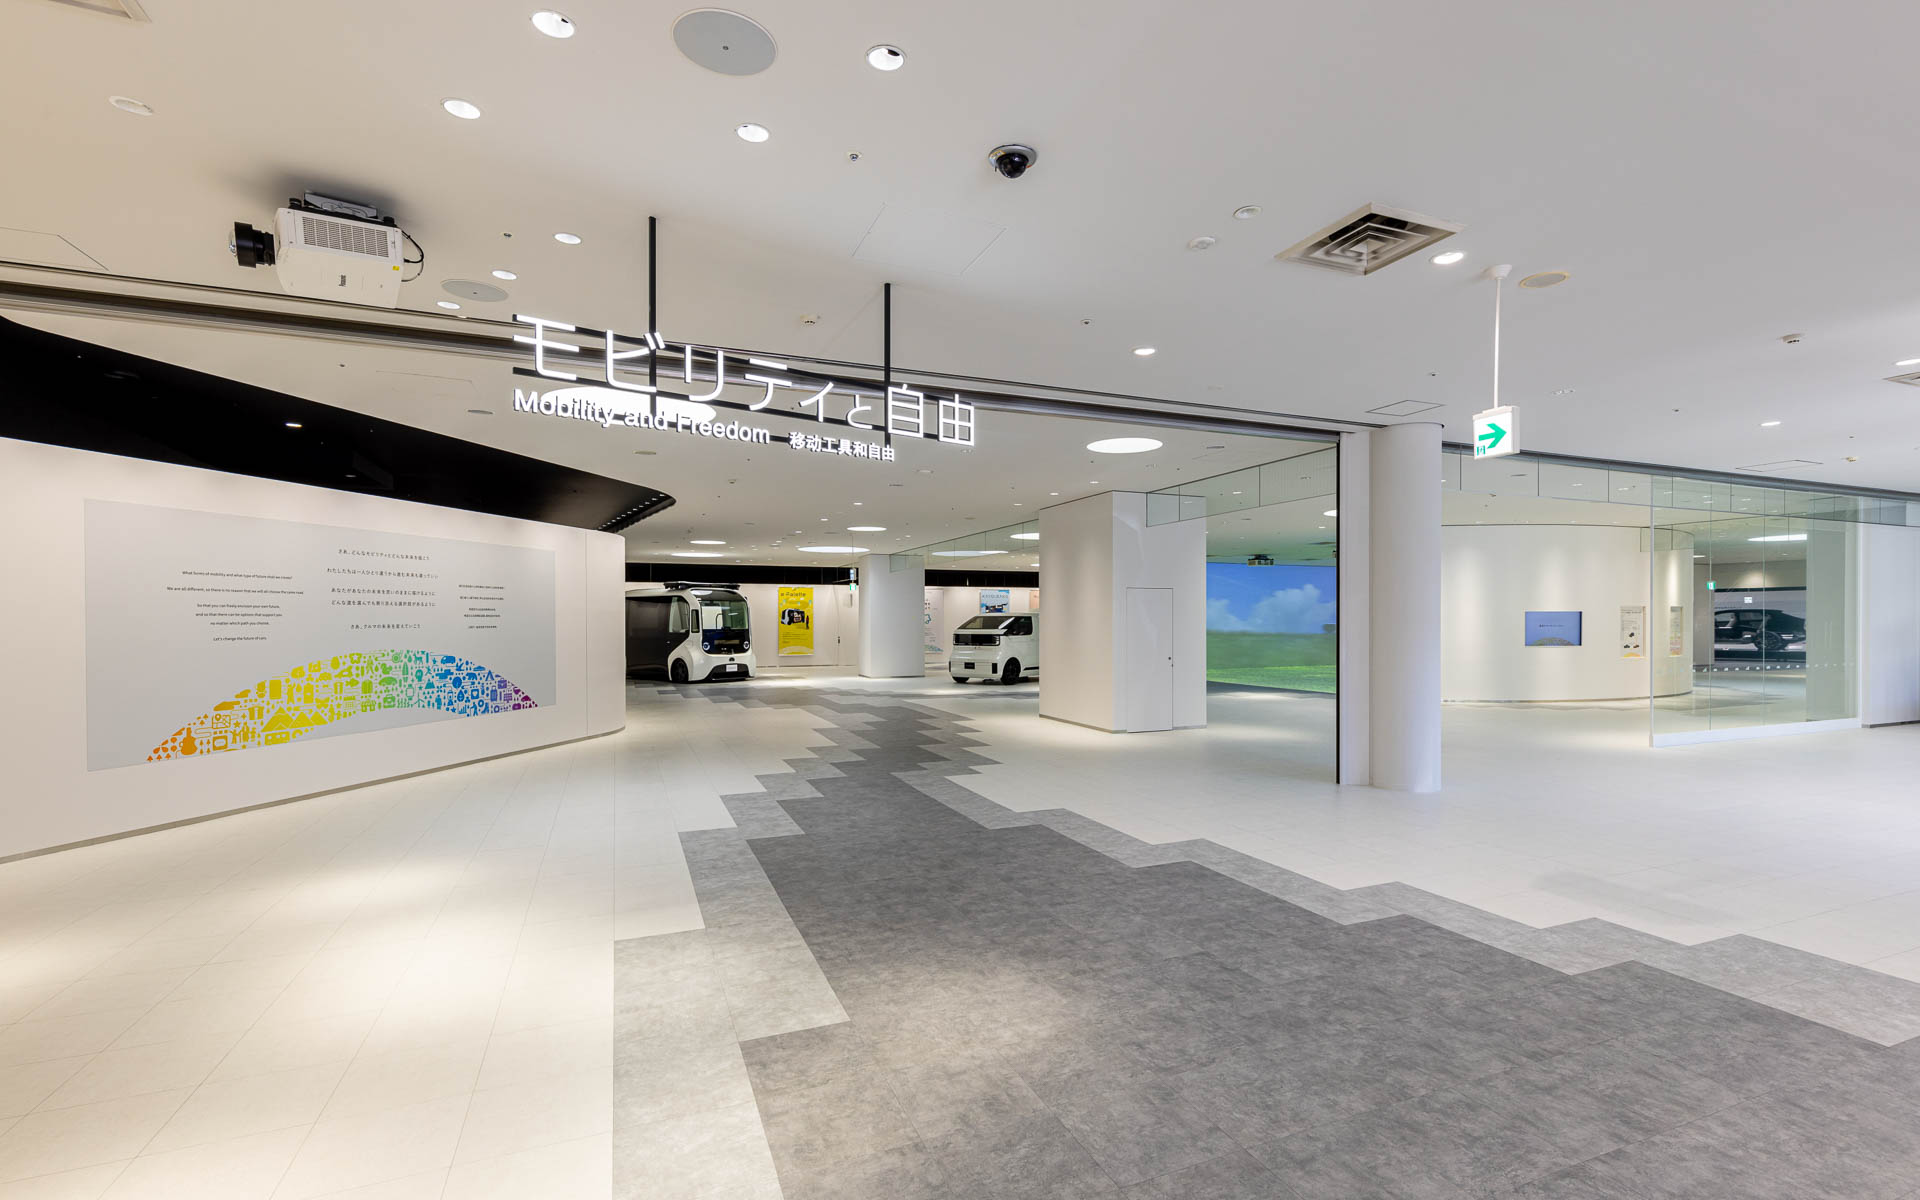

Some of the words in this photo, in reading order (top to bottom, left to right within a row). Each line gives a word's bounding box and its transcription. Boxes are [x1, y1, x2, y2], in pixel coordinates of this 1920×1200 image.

[513, 313, 975, 447] モビリティと自由
[513, 388, 614, 428] Mobility
[623, 404, 669, 432] and
[676, 413, 771, 445] Freedom
[789, 431, 896, 462] 移动工具和自由
